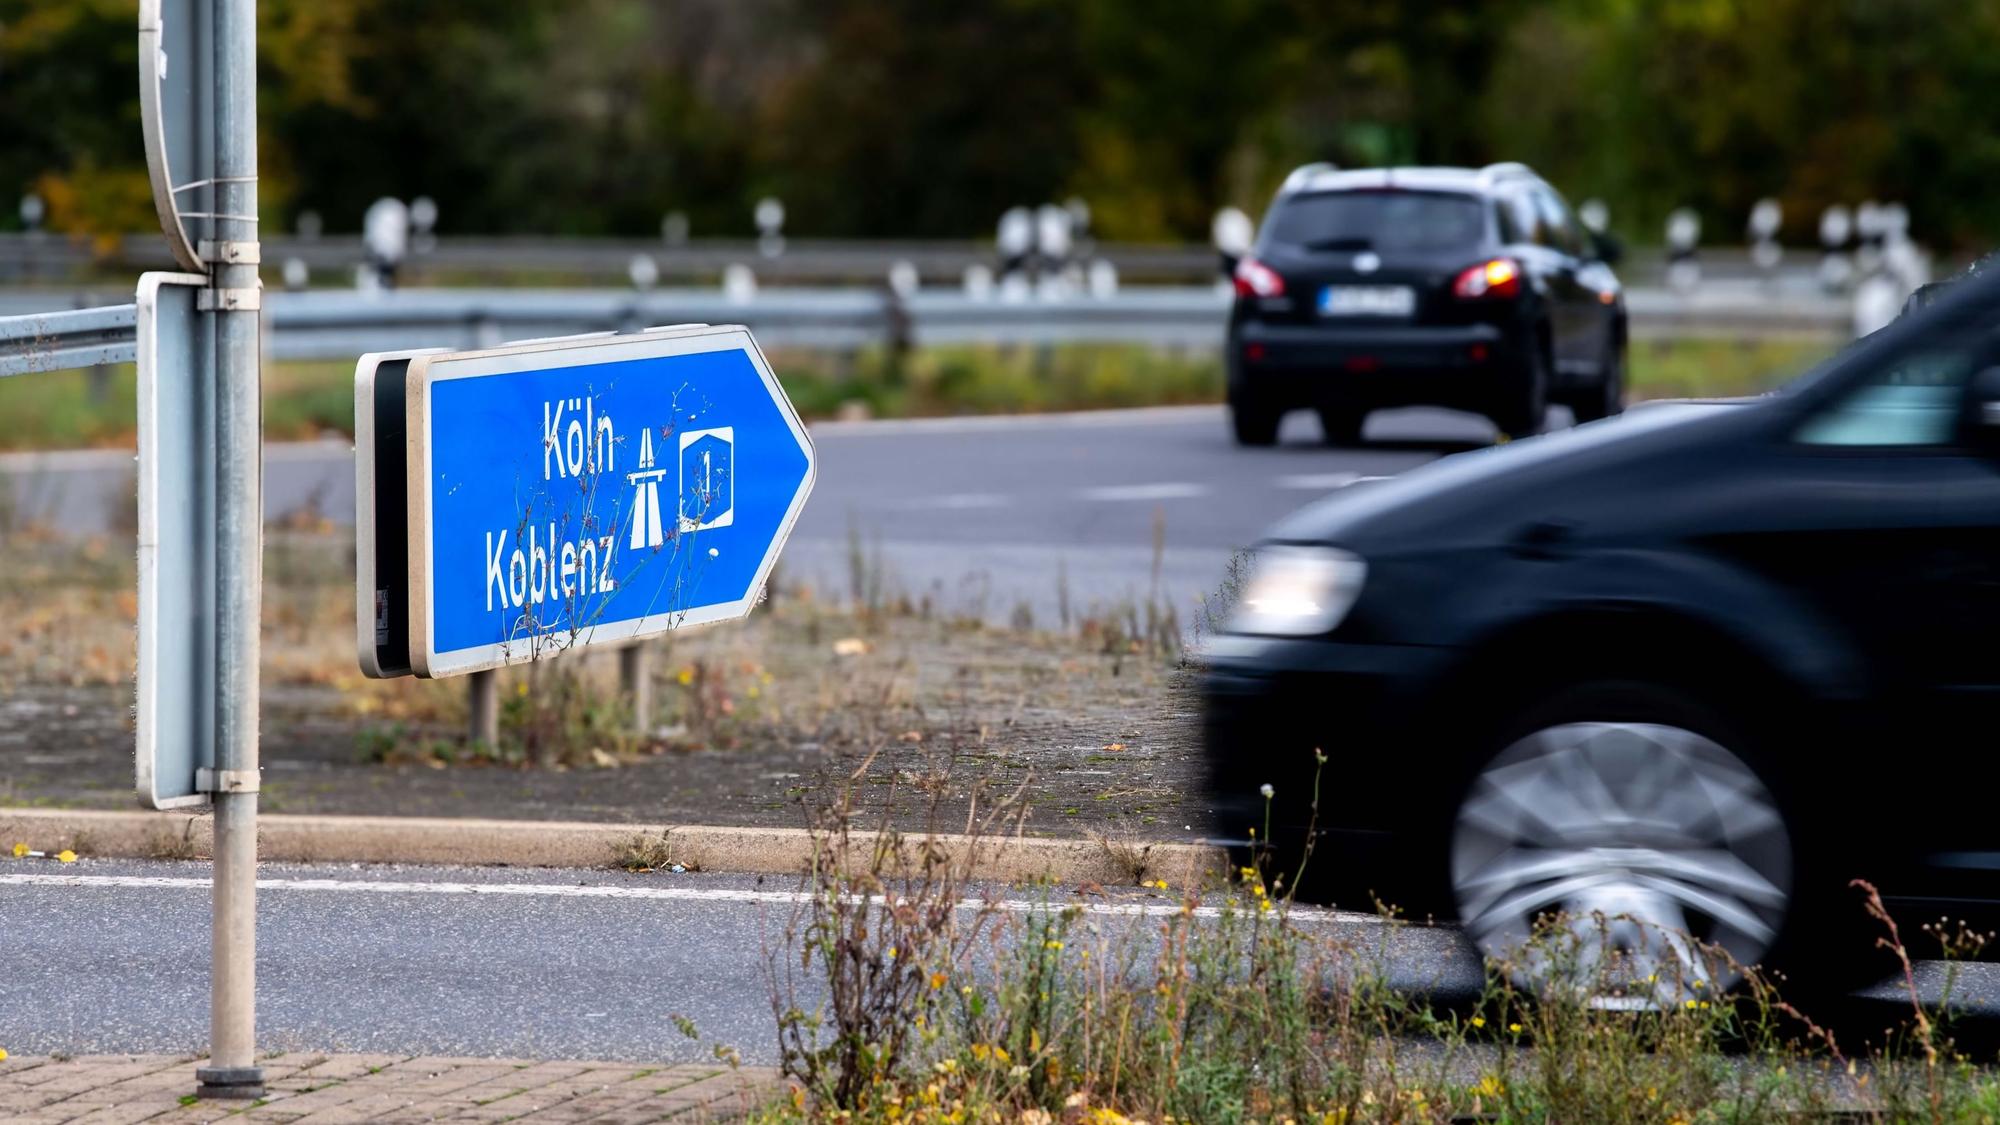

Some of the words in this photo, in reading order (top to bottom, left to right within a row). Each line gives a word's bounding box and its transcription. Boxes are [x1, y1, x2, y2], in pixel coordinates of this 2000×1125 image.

[544, 397, 614, 480] Köln
[702, 450, 711, 495] 1
[486, 523, 614, 611] Koblenz
